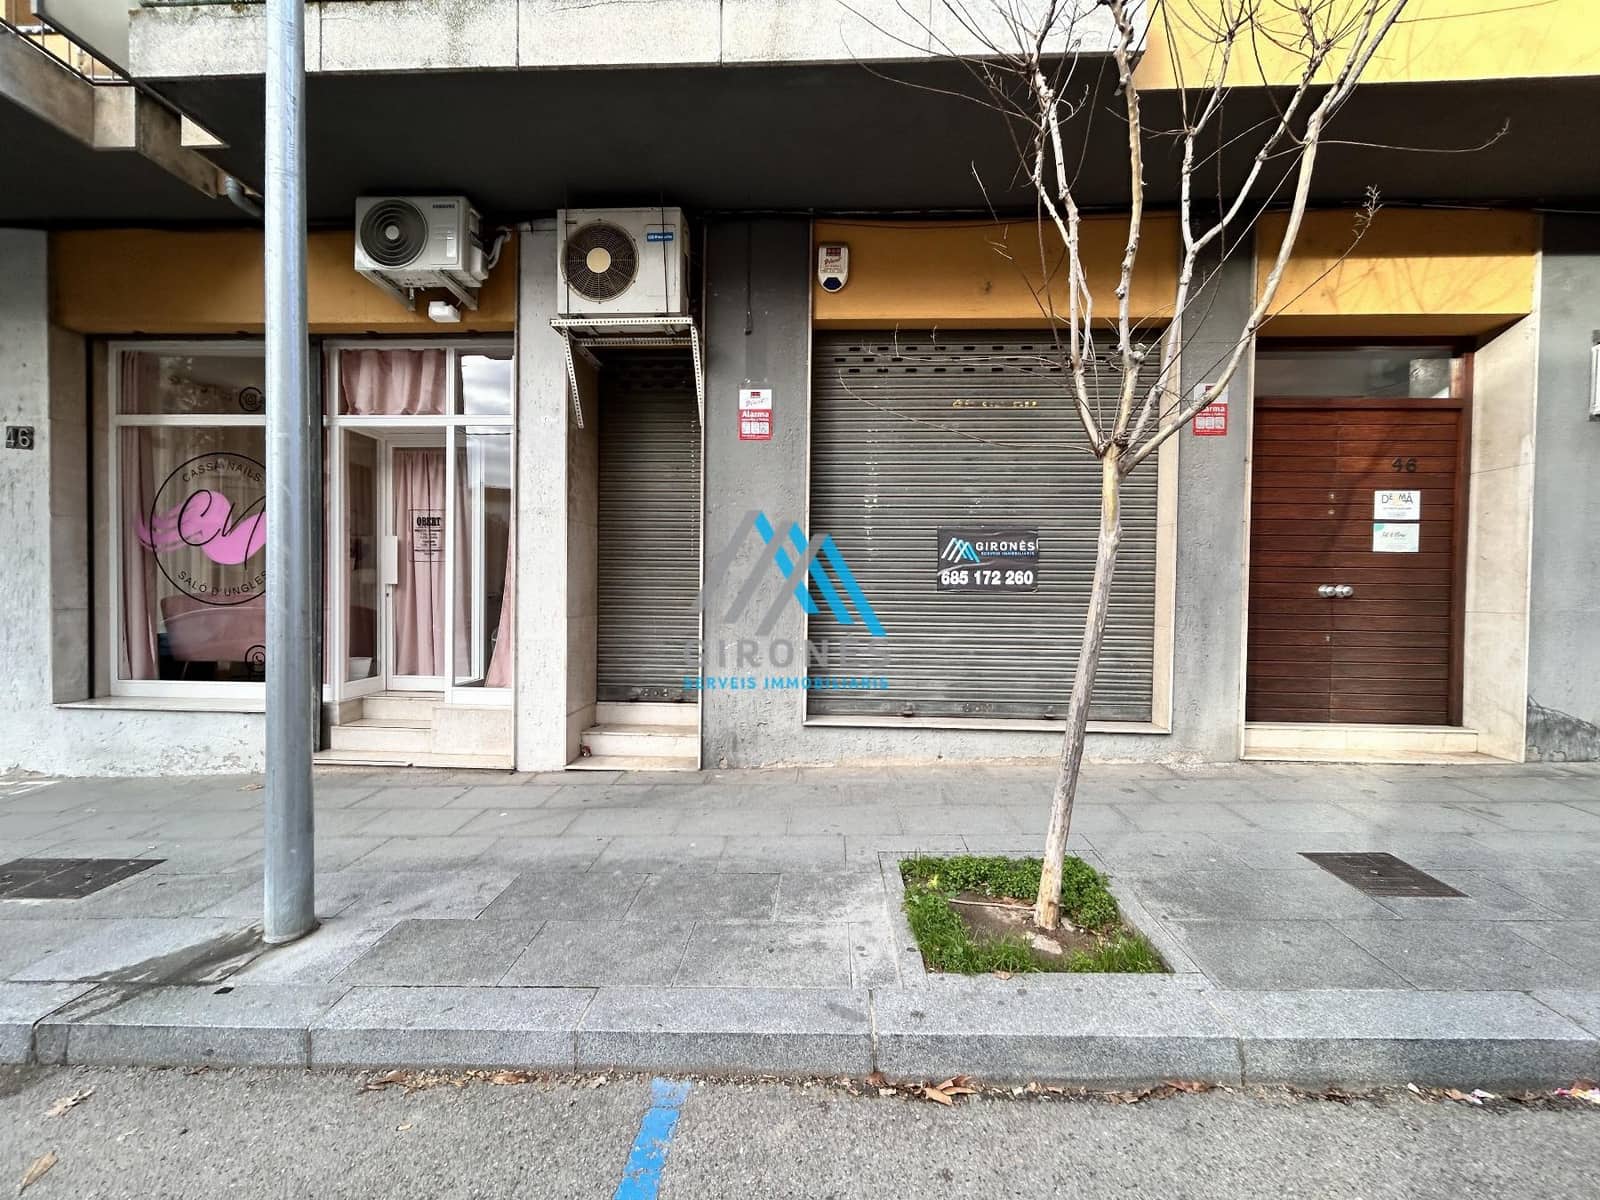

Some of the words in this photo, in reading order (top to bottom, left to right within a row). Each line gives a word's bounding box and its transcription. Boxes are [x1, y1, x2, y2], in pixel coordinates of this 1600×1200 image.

[742, 409, 770, 418] Alarma
[6, 428, 31, 448] 46
[1391, 456, 1417, 473] 46
[225, 464, 262, 487] NAILS
[416, 516, 441, 527] OBERT
[975, 540, 1036, 552] GIRONÈS
[940, 569, 969, 586] 685
[974, 569, 1001, 586] 172
[1004, 569, 1034, 586] 260
